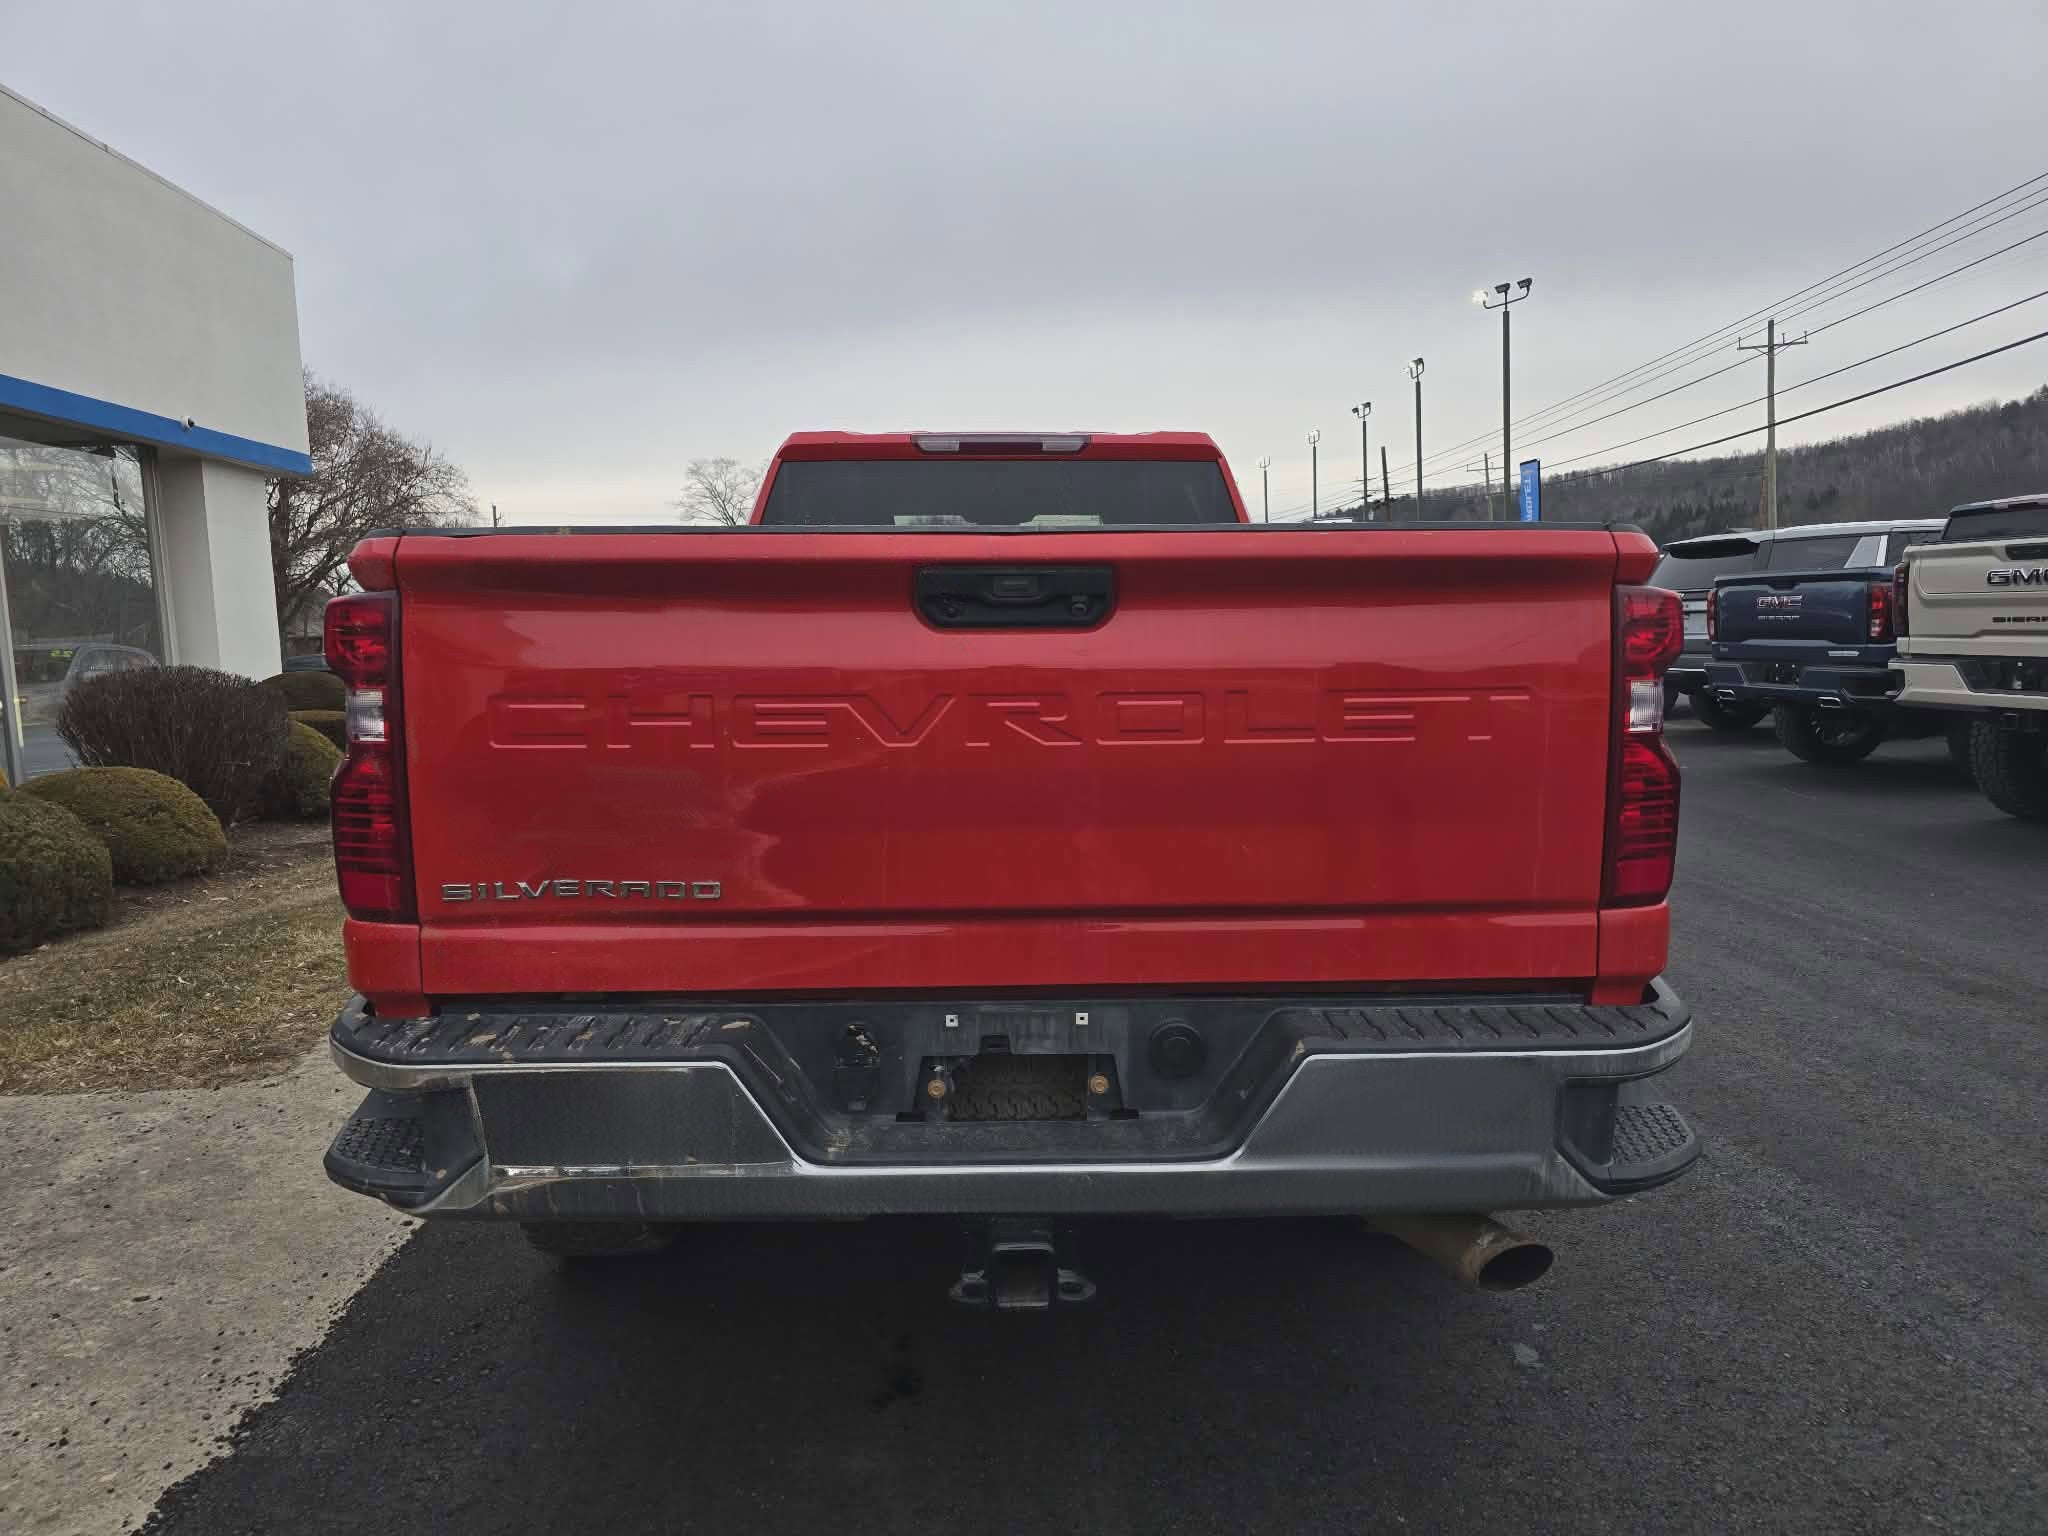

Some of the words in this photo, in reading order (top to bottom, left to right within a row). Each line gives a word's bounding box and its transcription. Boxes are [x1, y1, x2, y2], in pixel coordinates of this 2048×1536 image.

[1986, 568, 2048, 586] GM
[1757, 595, 1802, 609] GMC
[488, 687, 1532, 748] CHEVROLET
[441, 879, 721, 901] SILVERADO
